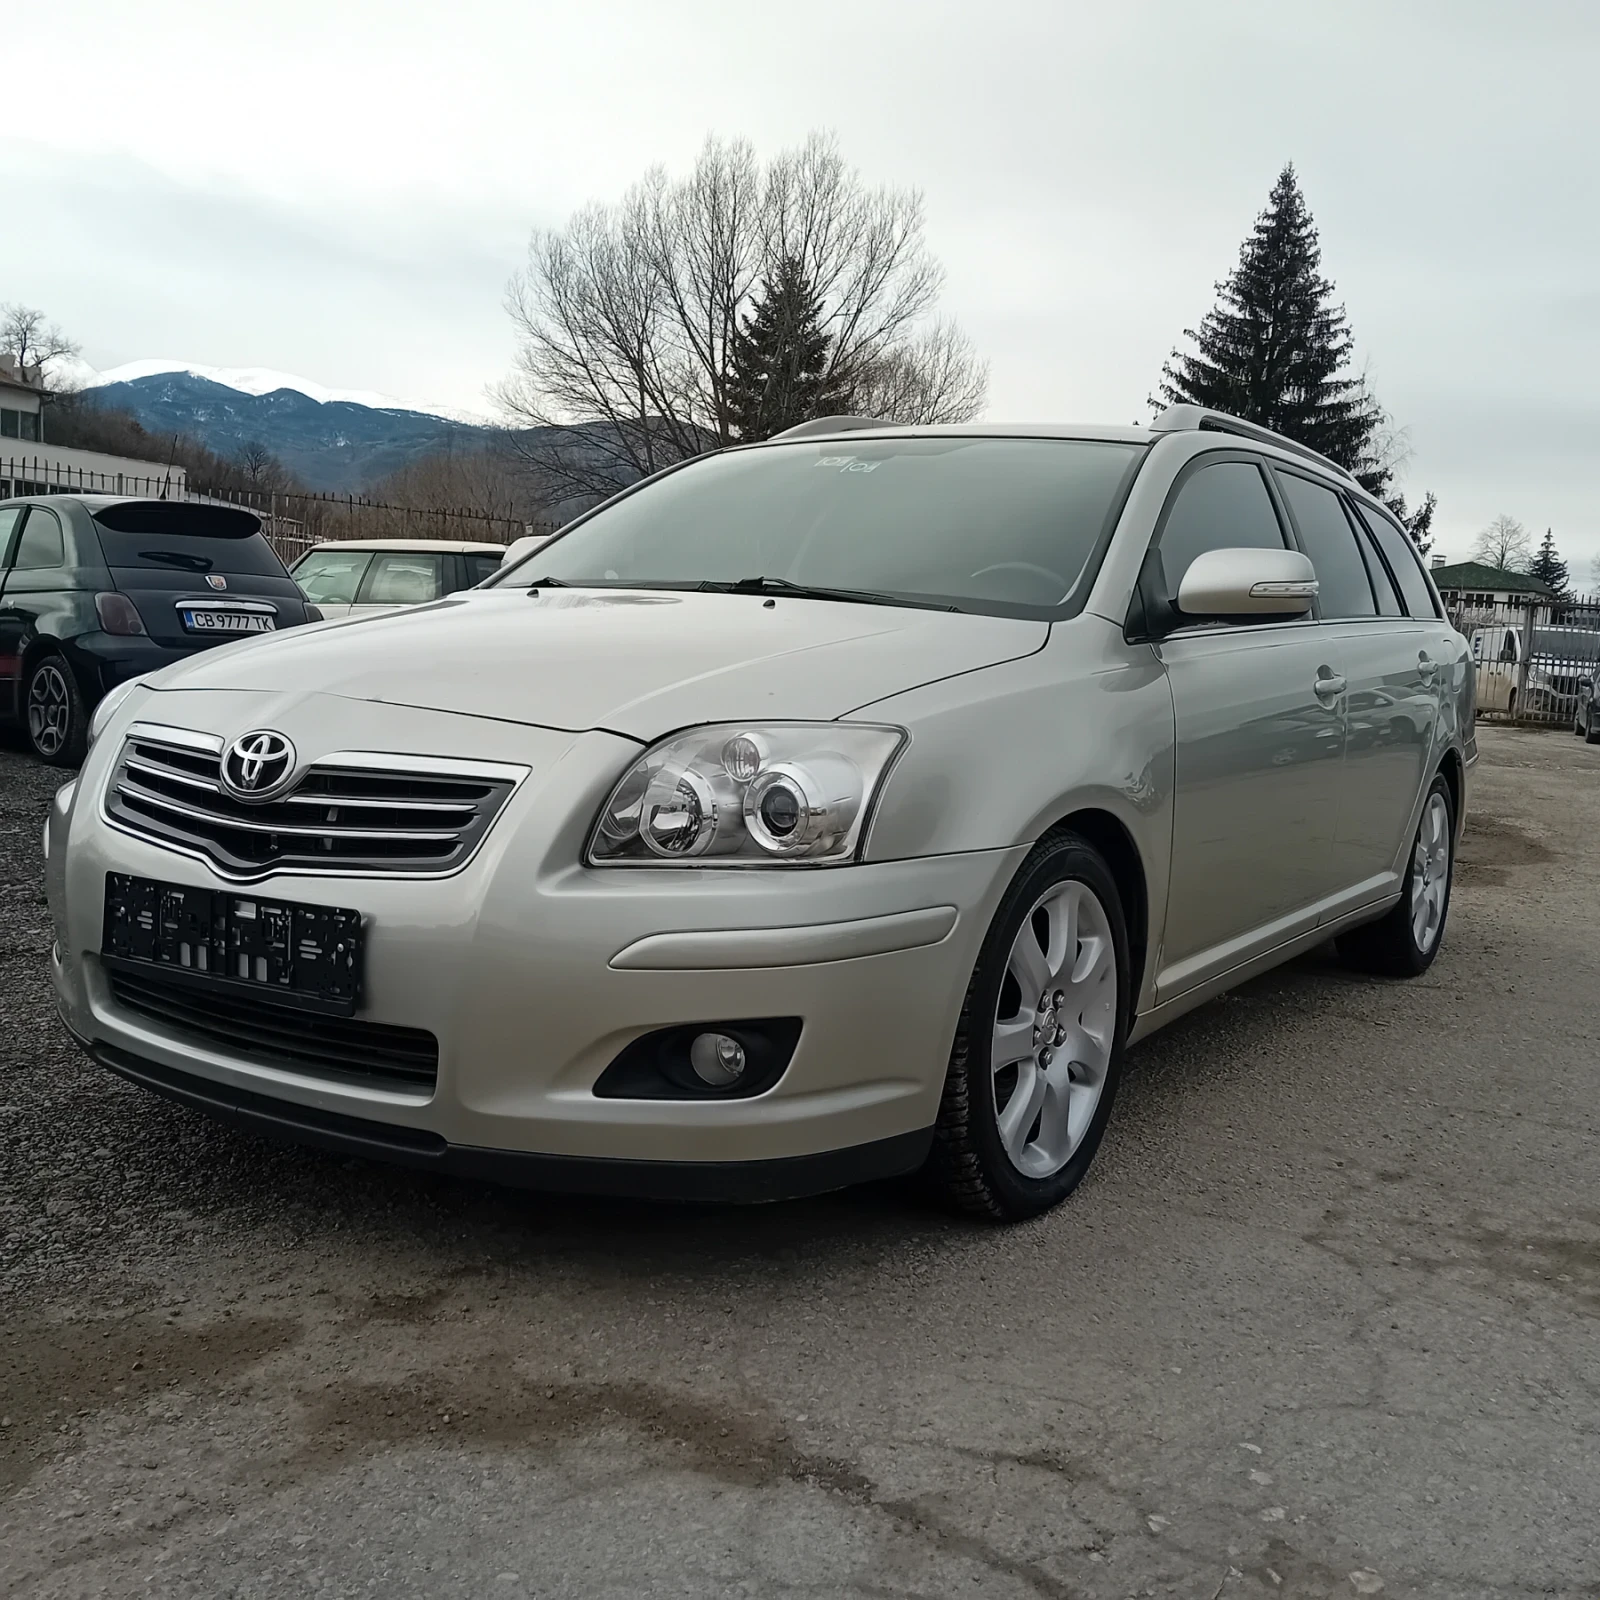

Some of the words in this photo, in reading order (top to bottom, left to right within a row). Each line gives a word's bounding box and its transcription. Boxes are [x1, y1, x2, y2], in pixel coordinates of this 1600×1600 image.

[195, 613, 215, 627] CB
[216, 614, 249, 629] 9777
[252, 616, 273, 631] TK
